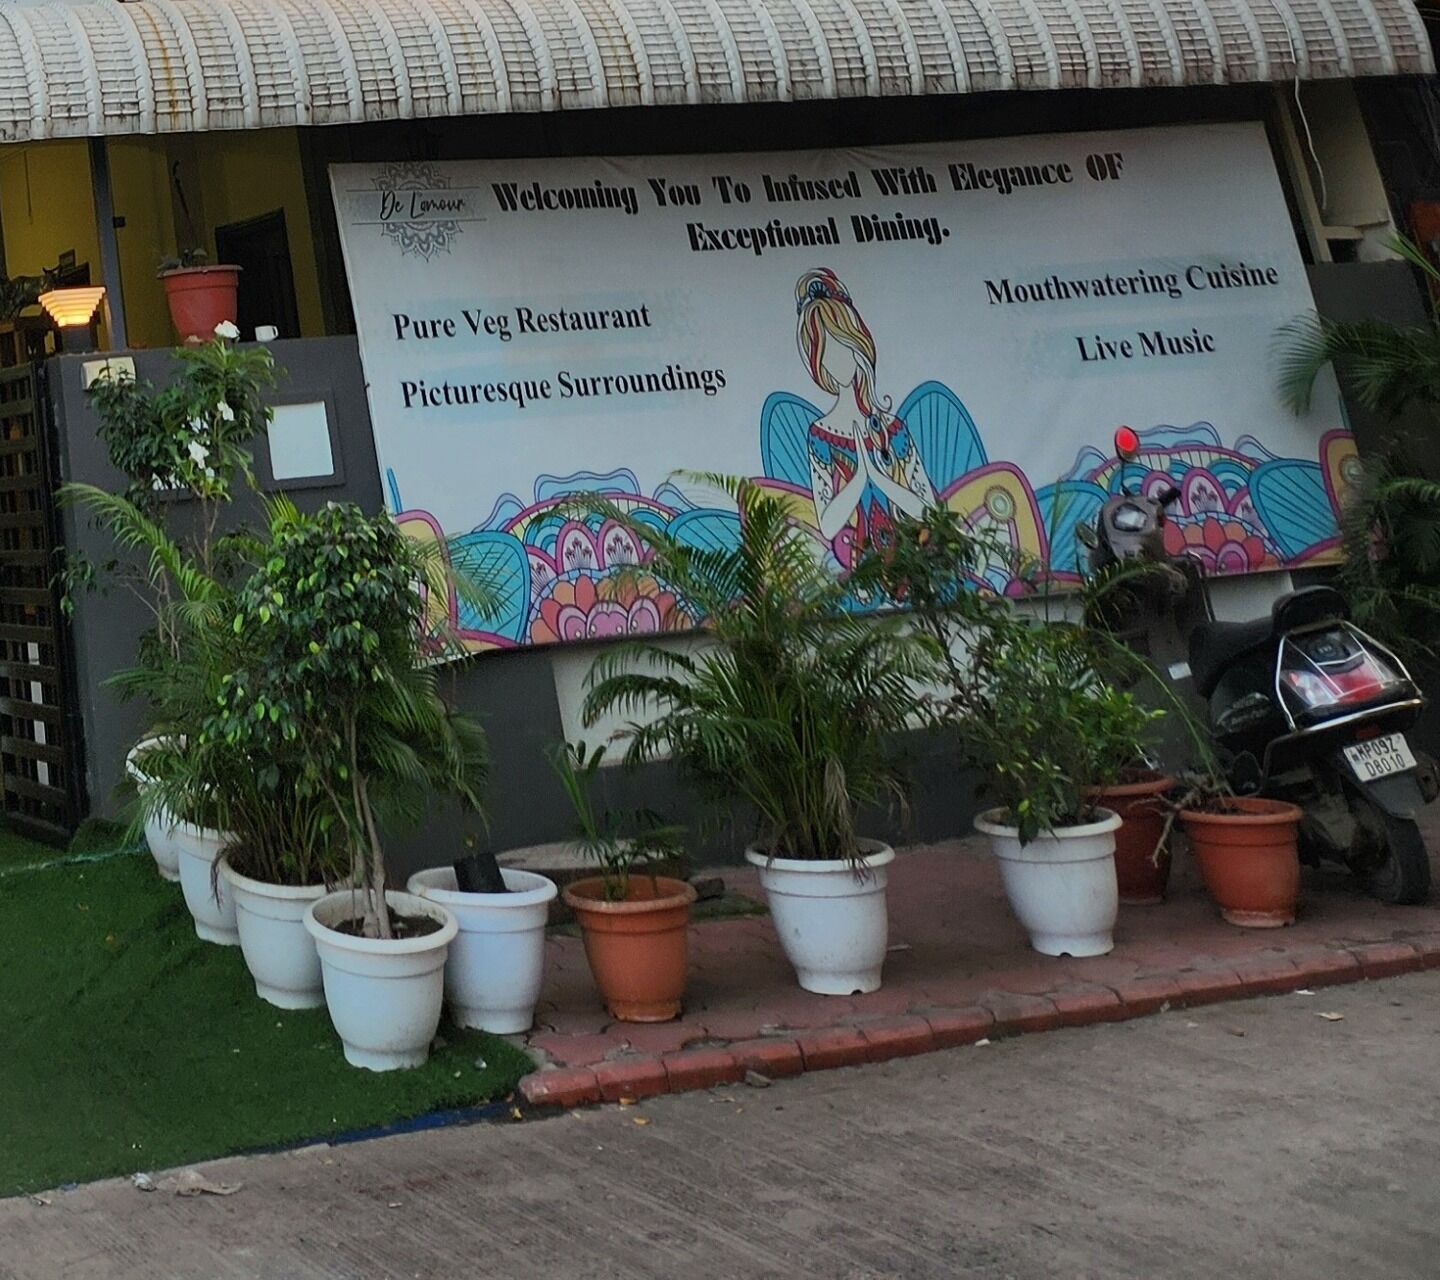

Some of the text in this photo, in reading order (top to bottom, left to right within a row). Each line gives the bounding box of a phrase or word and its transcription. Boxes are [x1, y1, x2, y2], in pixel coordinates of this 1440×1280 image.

[491, 152, 1124, 215] Welcoming You To Infused With Elegance OF
[686, 211, 950, 256] Exceptional Dining.
[984, 261, 1279, 305] Mouthwatering Cuisine
[392, 303, 652, 342] Pure Veg Restaurant
[1076, 327, 1217, 362] Live Music
[401, 363, 727, 409] Picturesque Surroundings
